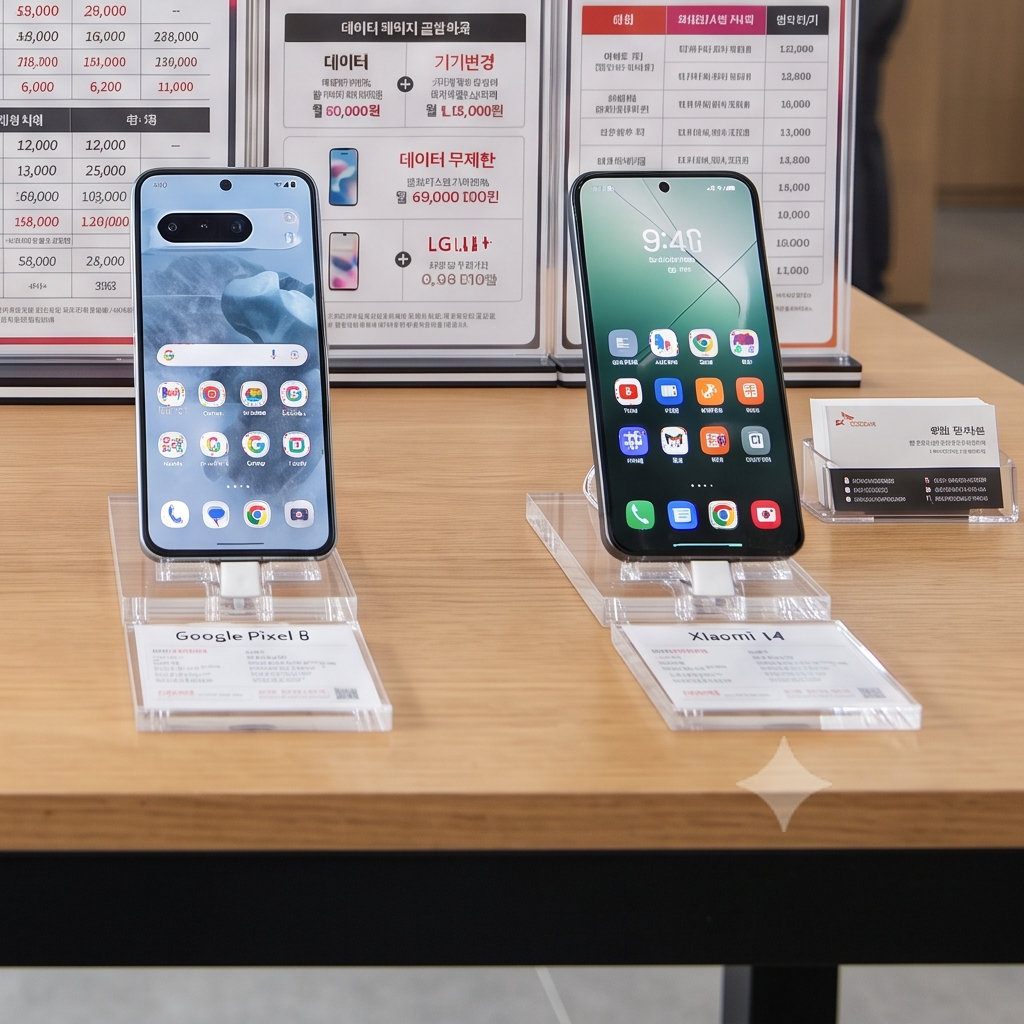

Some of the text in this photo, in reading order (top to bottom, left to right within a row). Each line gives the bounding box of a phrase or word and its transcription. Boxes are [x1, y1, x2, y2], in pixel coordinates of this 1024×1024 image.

[324, 53, 369, 71] 데이터
[435, 53, 495, 72] 기기변경
[21, 81, 55, 95] 6,000
[89, 81, 122, 95] 6,200
[17, 139, 58, 153] 12,000
[85, 139, 126, 153] 12,000
[399, 151, 497, 169] 데이터 무제한
[85, 164, 127, 179] 25,000
[412, 190, 460, 206] 69,000
[176, 630, 243, 643] Google
[248, 630, 293, 641] Pixel
